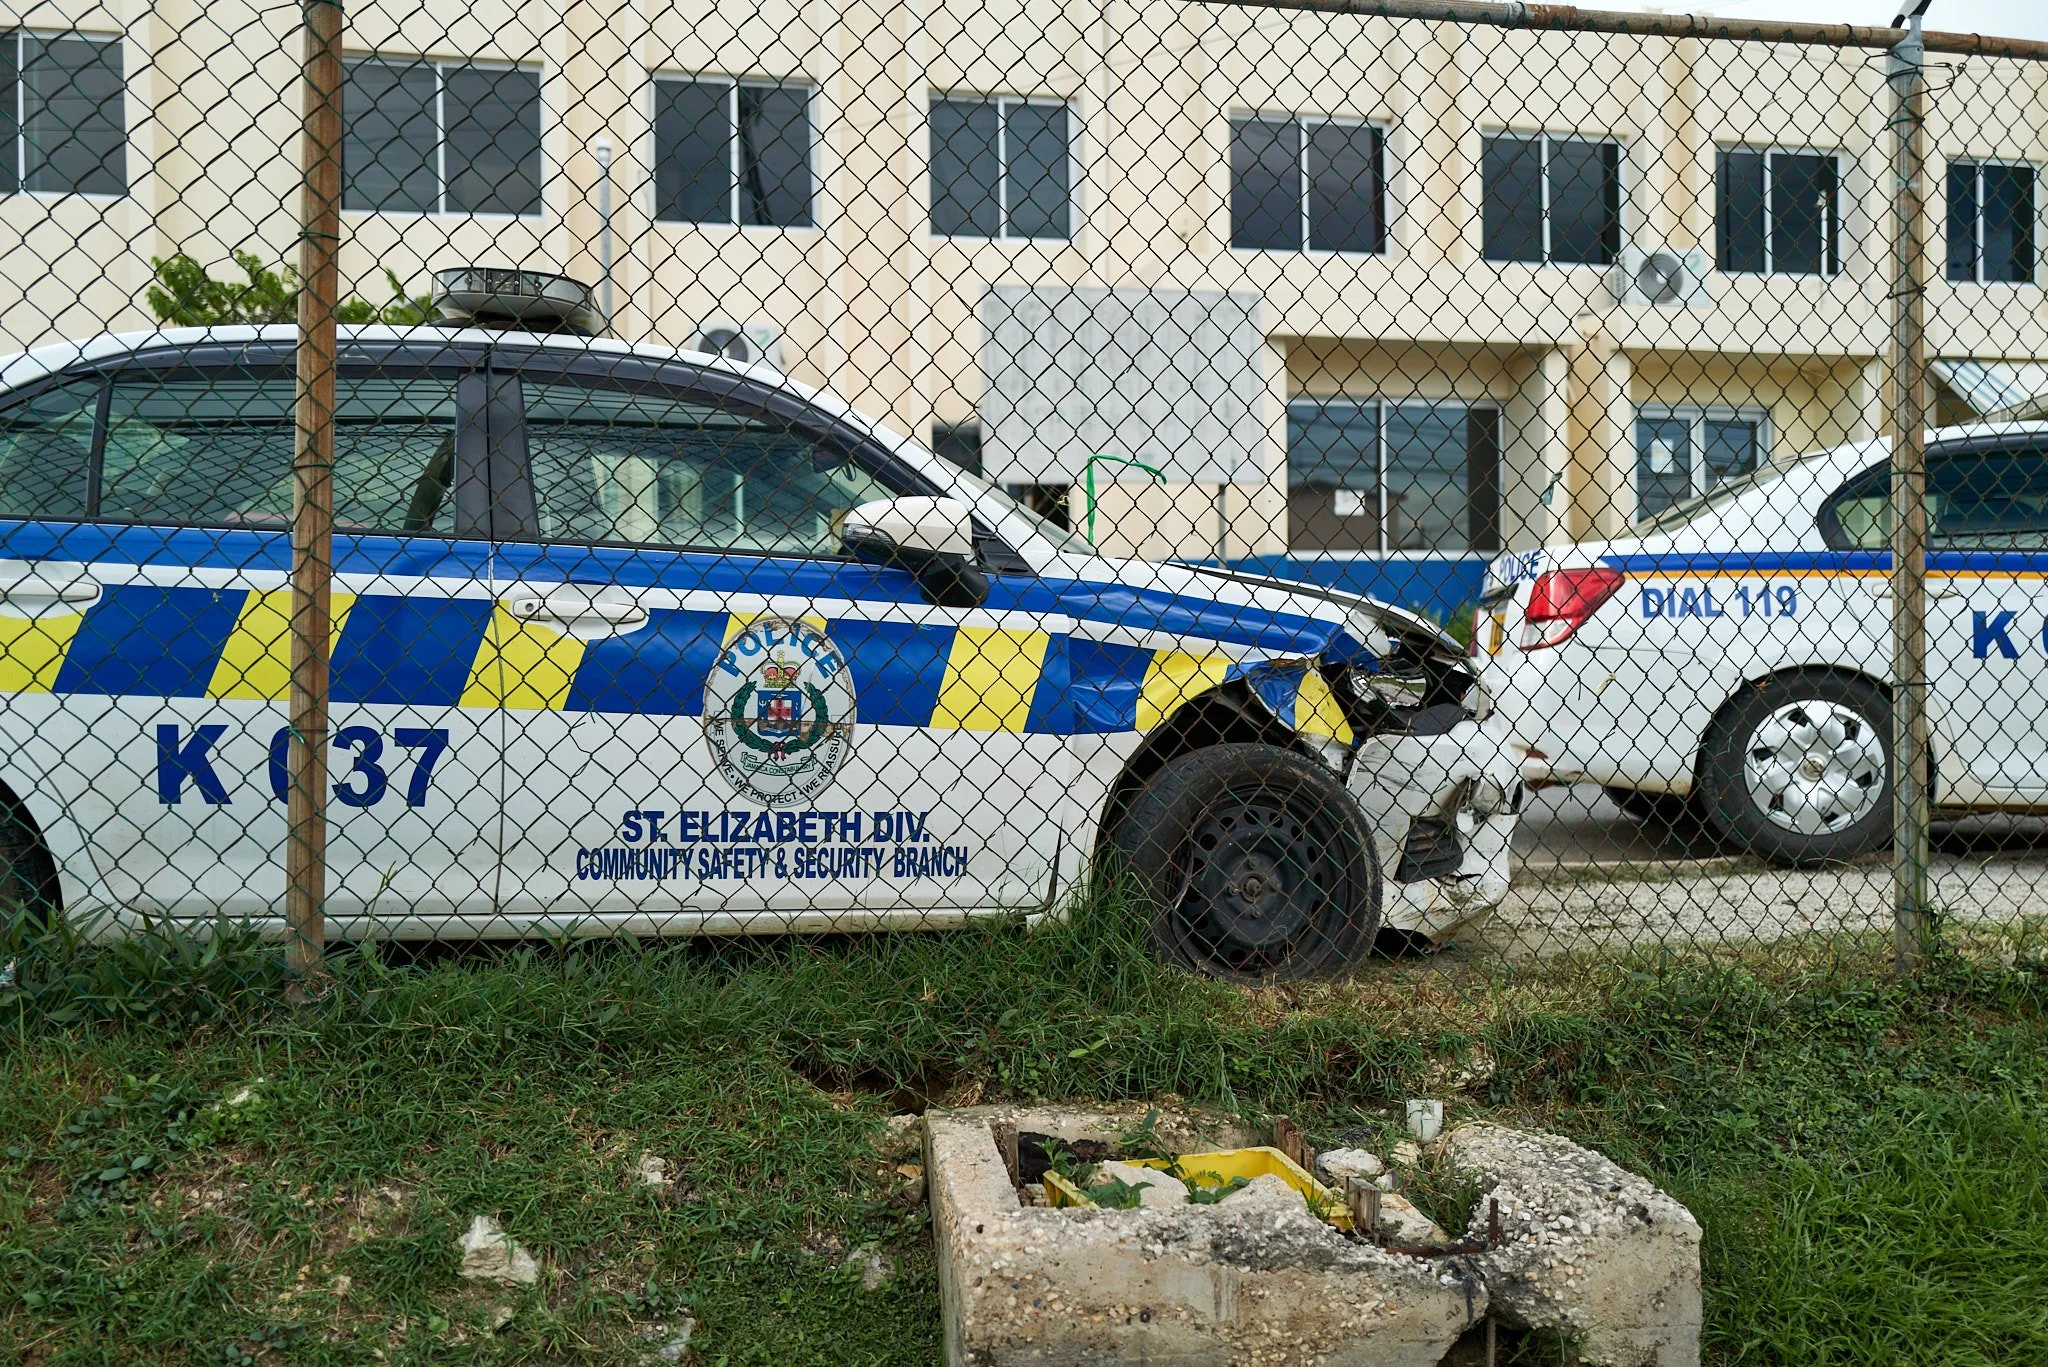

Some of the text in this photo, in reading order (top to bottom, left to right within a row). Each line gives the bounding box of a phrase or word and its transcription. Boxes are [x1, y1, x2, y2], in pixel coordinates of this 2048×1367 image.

[1499, 551, 1541, 582] POLICE
[1642, 585, 1798, 619] DIAL 119
[718, 621, 843, 679] POLICE
[1973, 611, 2020, 659] K
[156, 724, 233, 804] K
[715, 718, 724, 736] WE
[734, 777, 749, 794] WE
[750, 786, 797, 804] PROTECT
[802, 779, 820, 794] WE
[820, 724, 842, 780] REASSUR
[622, 810, 930, 843] ST. ELIZABETH DIV.
[576, 846, 968, 881] COMMUNITY SAFETY & SECURITY BRANCH
